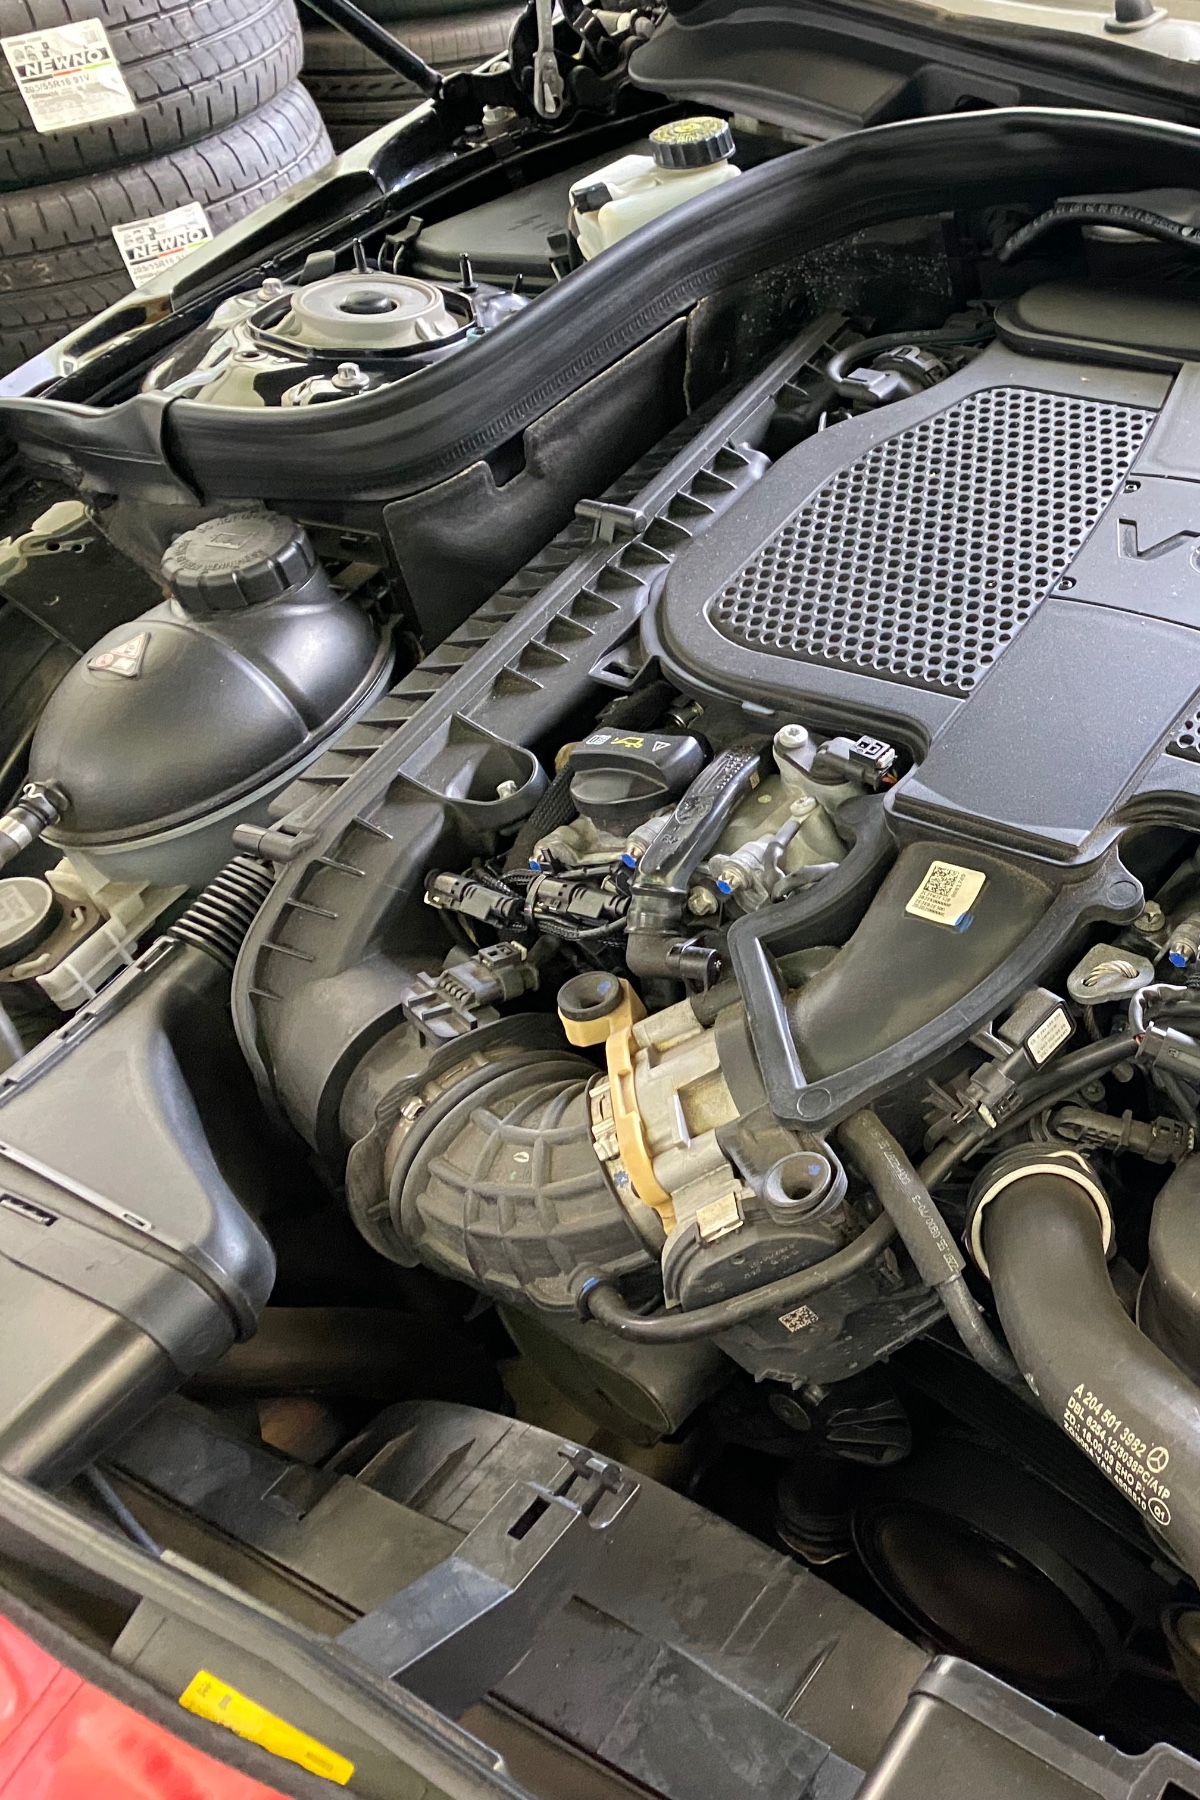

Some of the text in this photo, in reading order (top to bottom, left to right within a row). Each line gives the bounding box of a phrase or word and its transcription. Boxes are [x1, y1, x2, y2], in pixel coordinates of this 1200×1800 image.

[24, 51, 105, 77] NEWNO
[133, 229, 204, 260] NEWNO
[1067, 1396, 1085, 1421] DBL
[1074, 1384, 1147, 1457] A 204 501 3982
